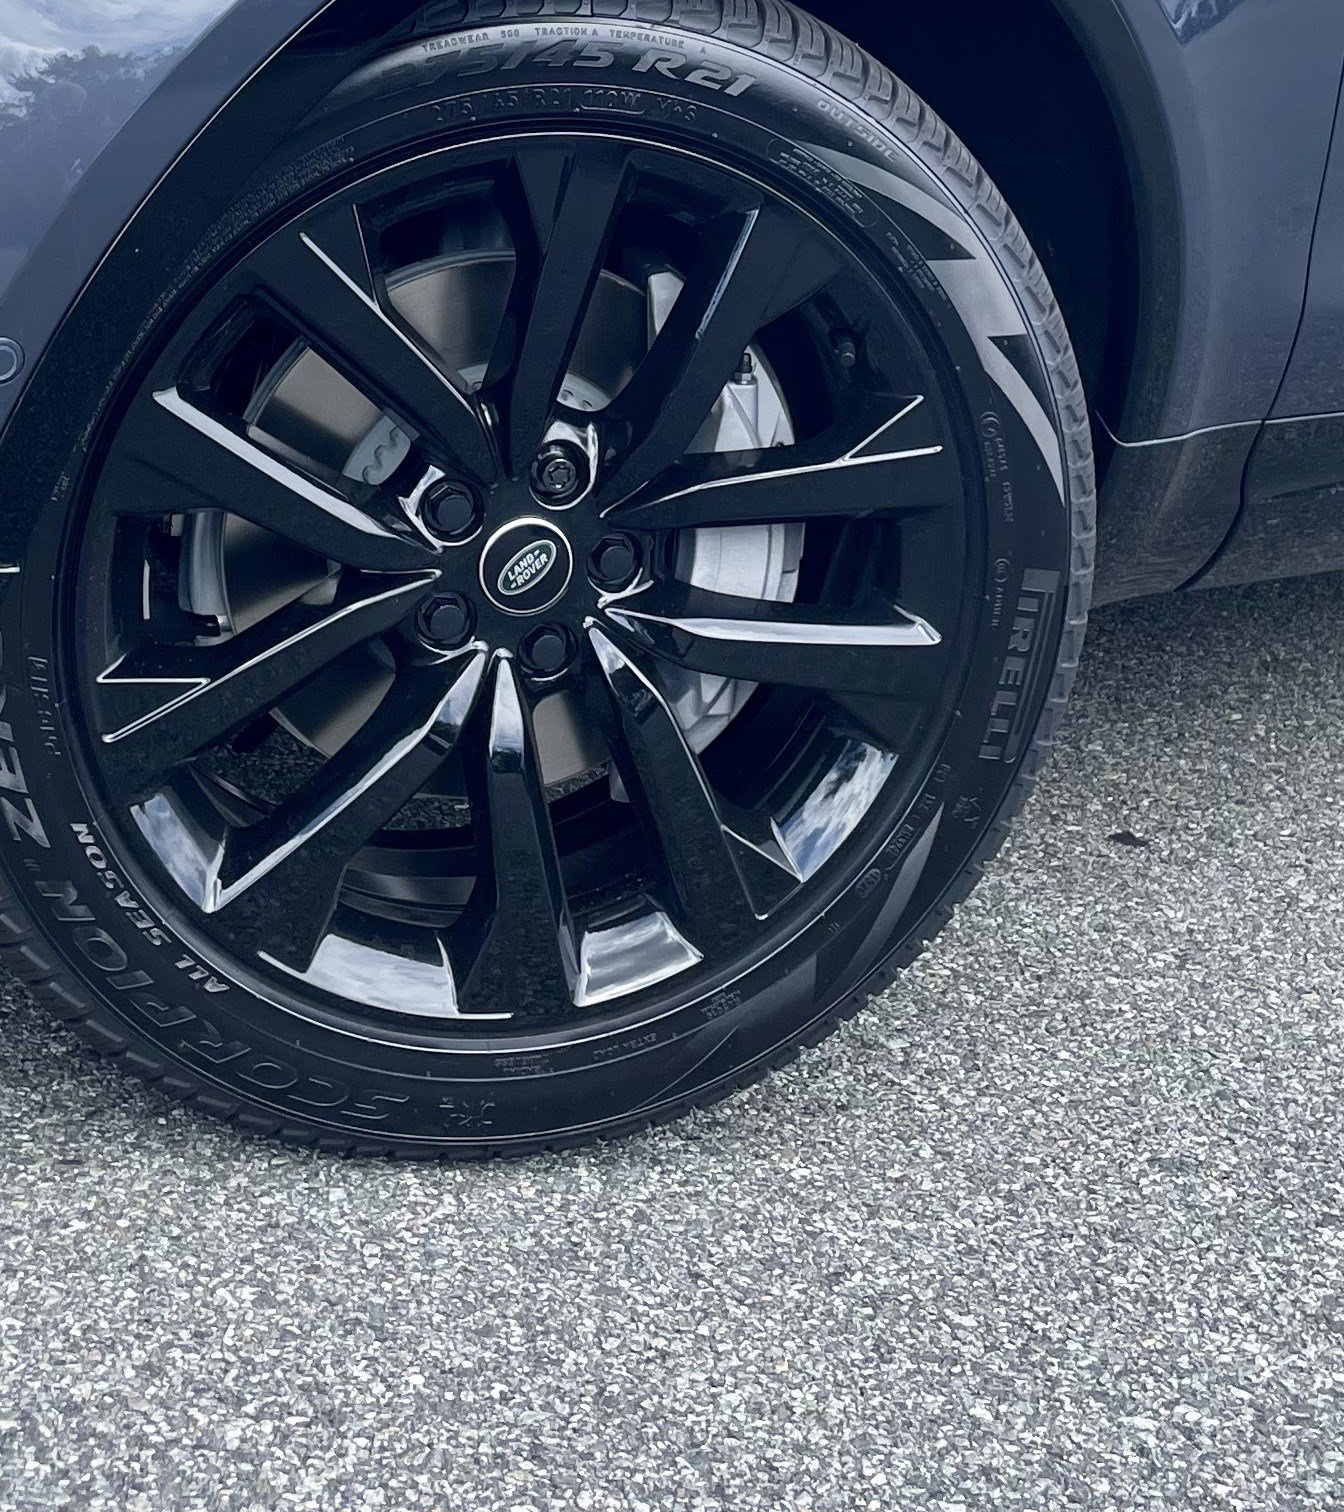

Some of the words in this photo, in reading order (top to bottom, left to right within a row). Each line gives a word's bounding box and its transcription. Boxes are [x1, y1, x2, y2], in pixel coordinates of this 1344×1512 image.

[534, 26, 587, 37] TRACTION
[609, 29, 685, 49] TEMPERATURE
[816, 98, 901, 162] OUTSIDE
[70, 823, 173, 946] SEASON
[174, 953, 231, 993] ALL
